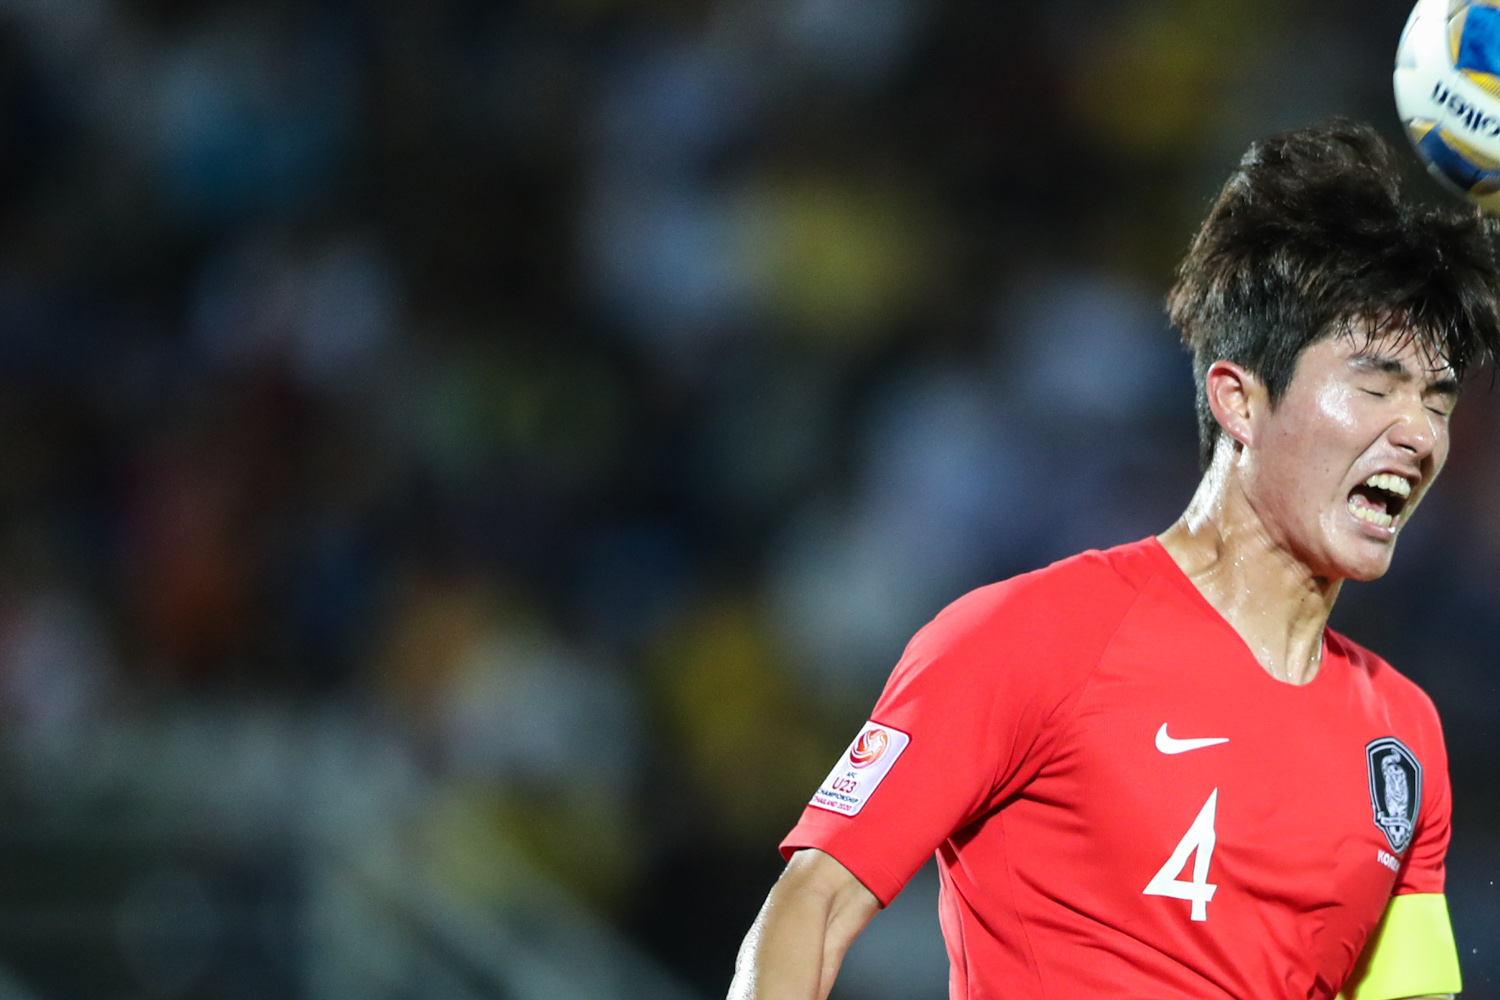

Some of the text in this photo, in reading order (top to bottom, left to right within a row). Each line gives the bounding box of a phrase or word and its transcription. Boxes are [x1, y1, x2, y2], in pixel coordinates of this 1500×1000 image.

[832, 776, 857, 793] U23
[817, 788, 858, 803] CHAMPIONSHIP
[1142, 787, 1217, 921] 4
